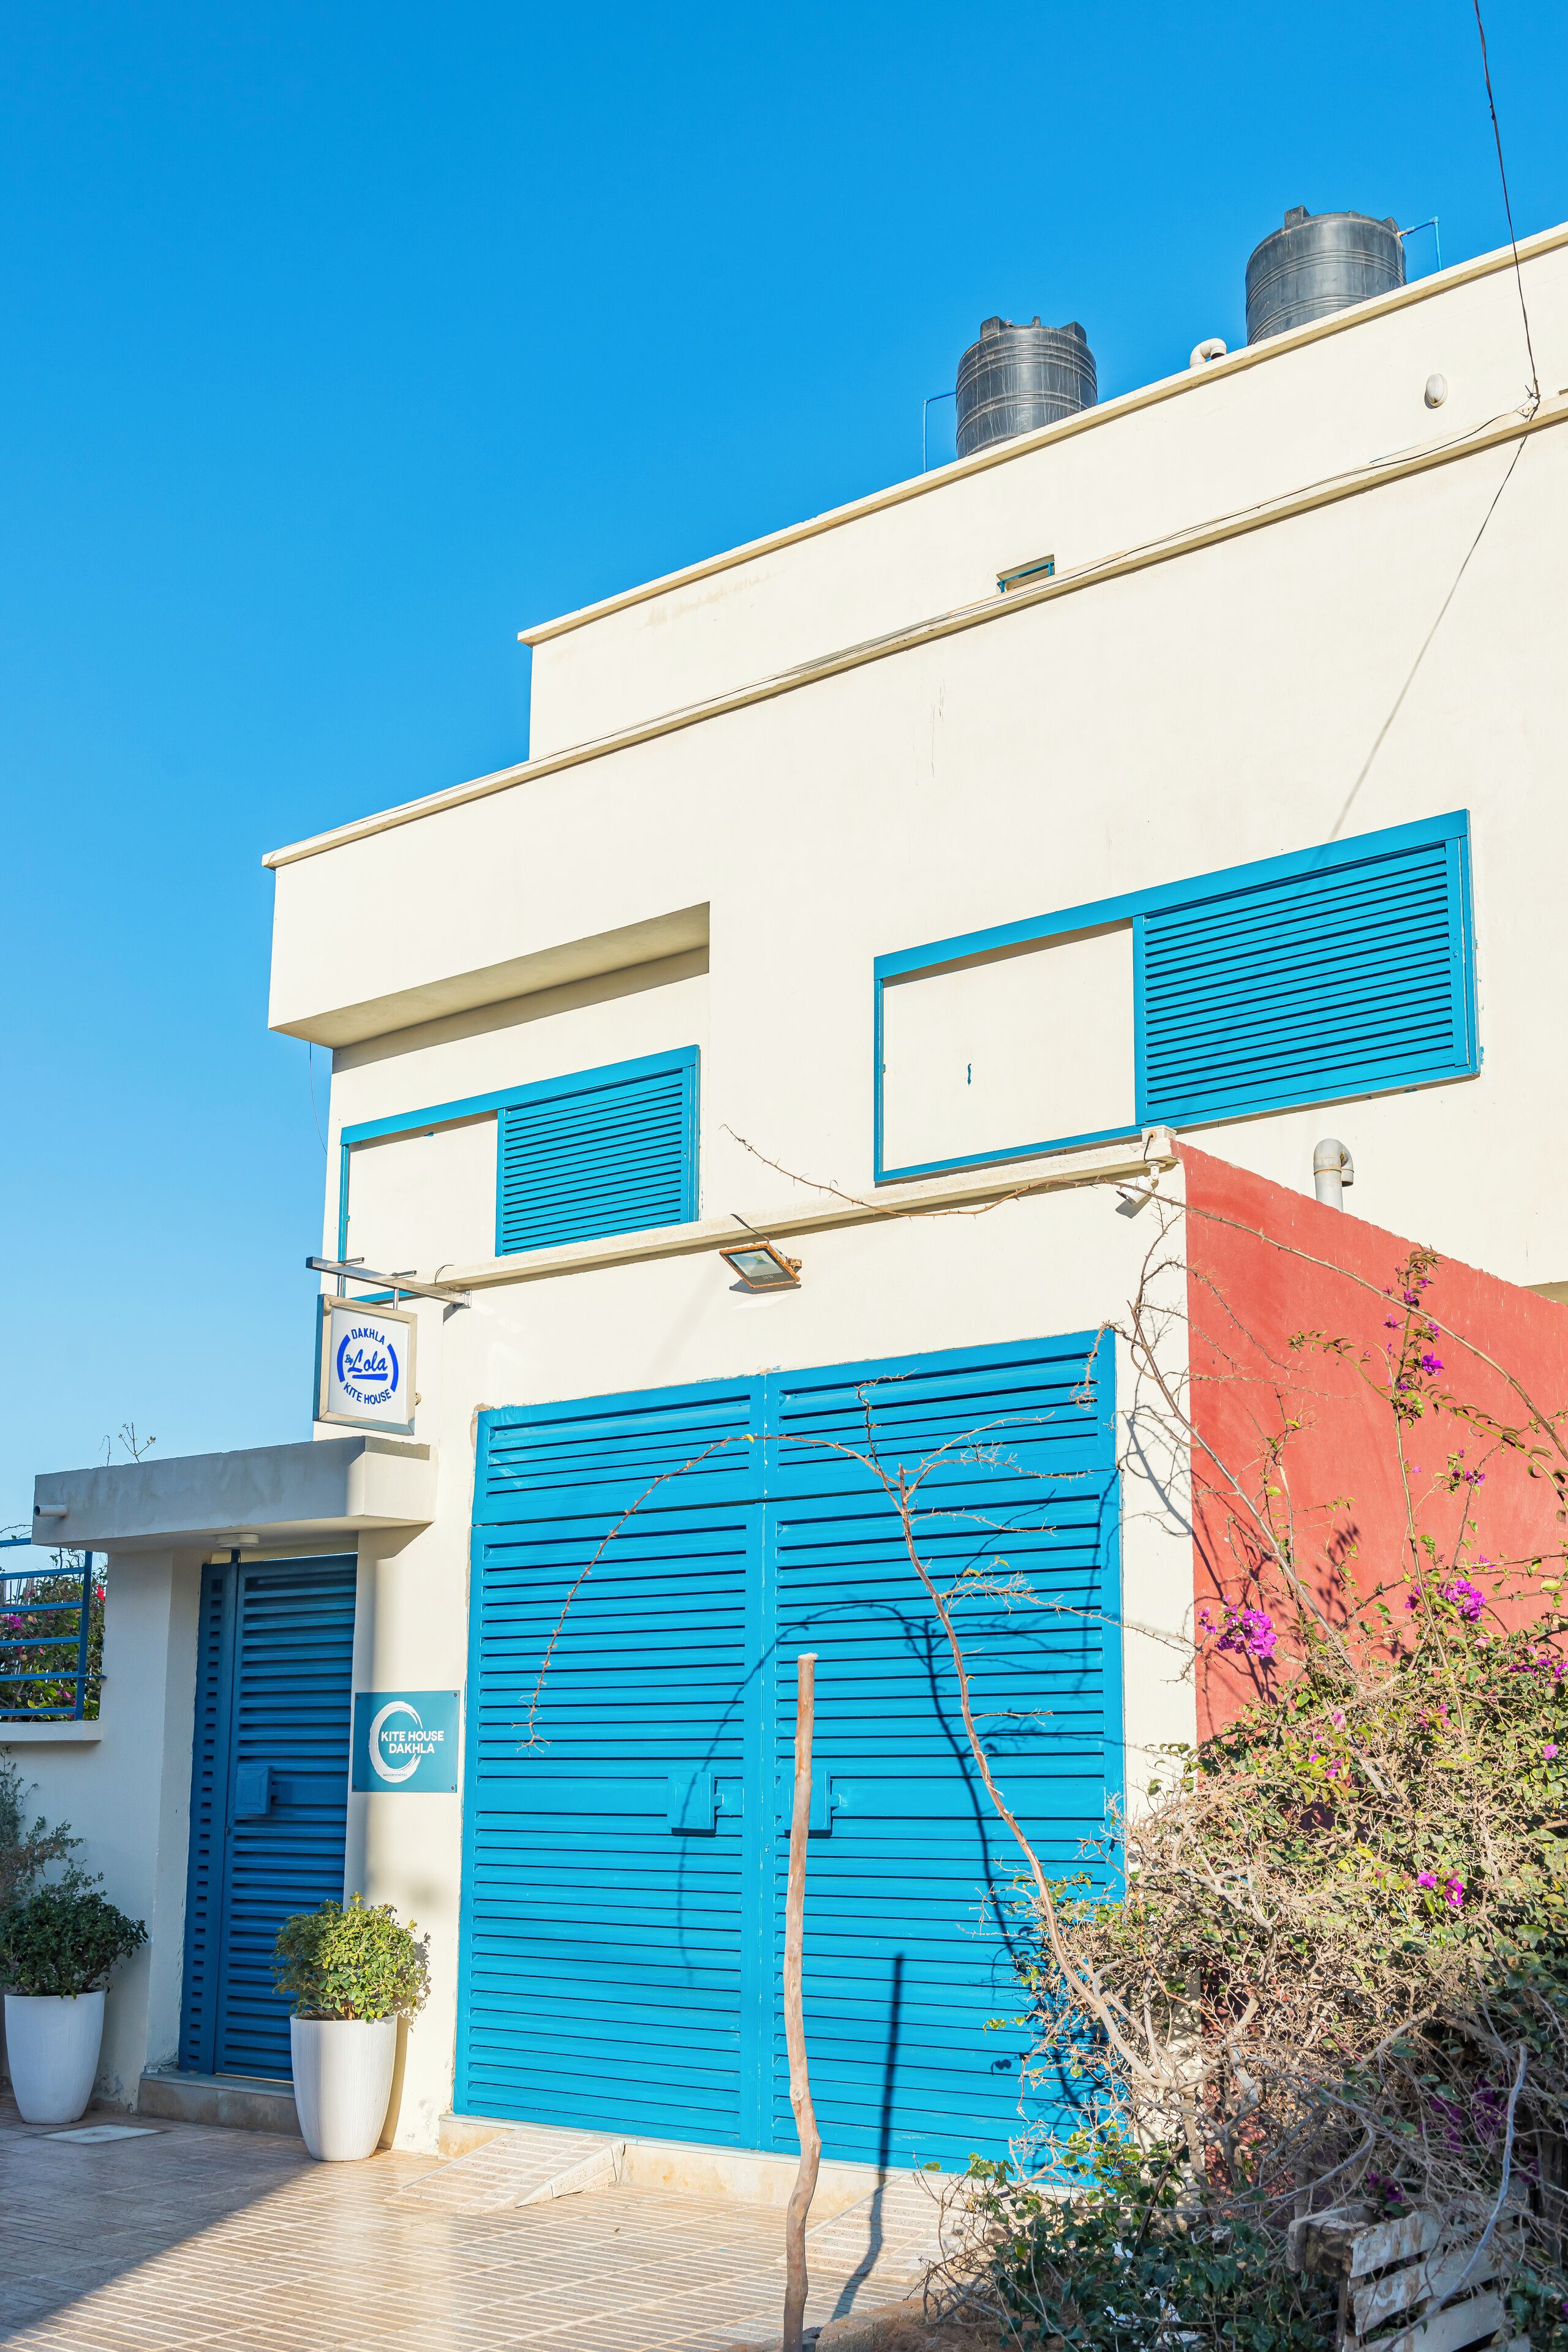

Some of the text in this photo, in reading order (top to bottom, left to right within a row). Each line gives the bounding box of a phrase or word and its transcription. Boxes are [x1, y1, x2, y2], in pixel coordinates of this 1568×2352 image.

[351, 1327, 385, 1345] DAKHLA
[347, 1349, 388, 1373] Lola
[343, 1382, 392, 1404] KITE HOUSE
[381, 1730, 444, 1742] KITE HOUSE
[389, 1743, 435, 1754] DAKHLA
